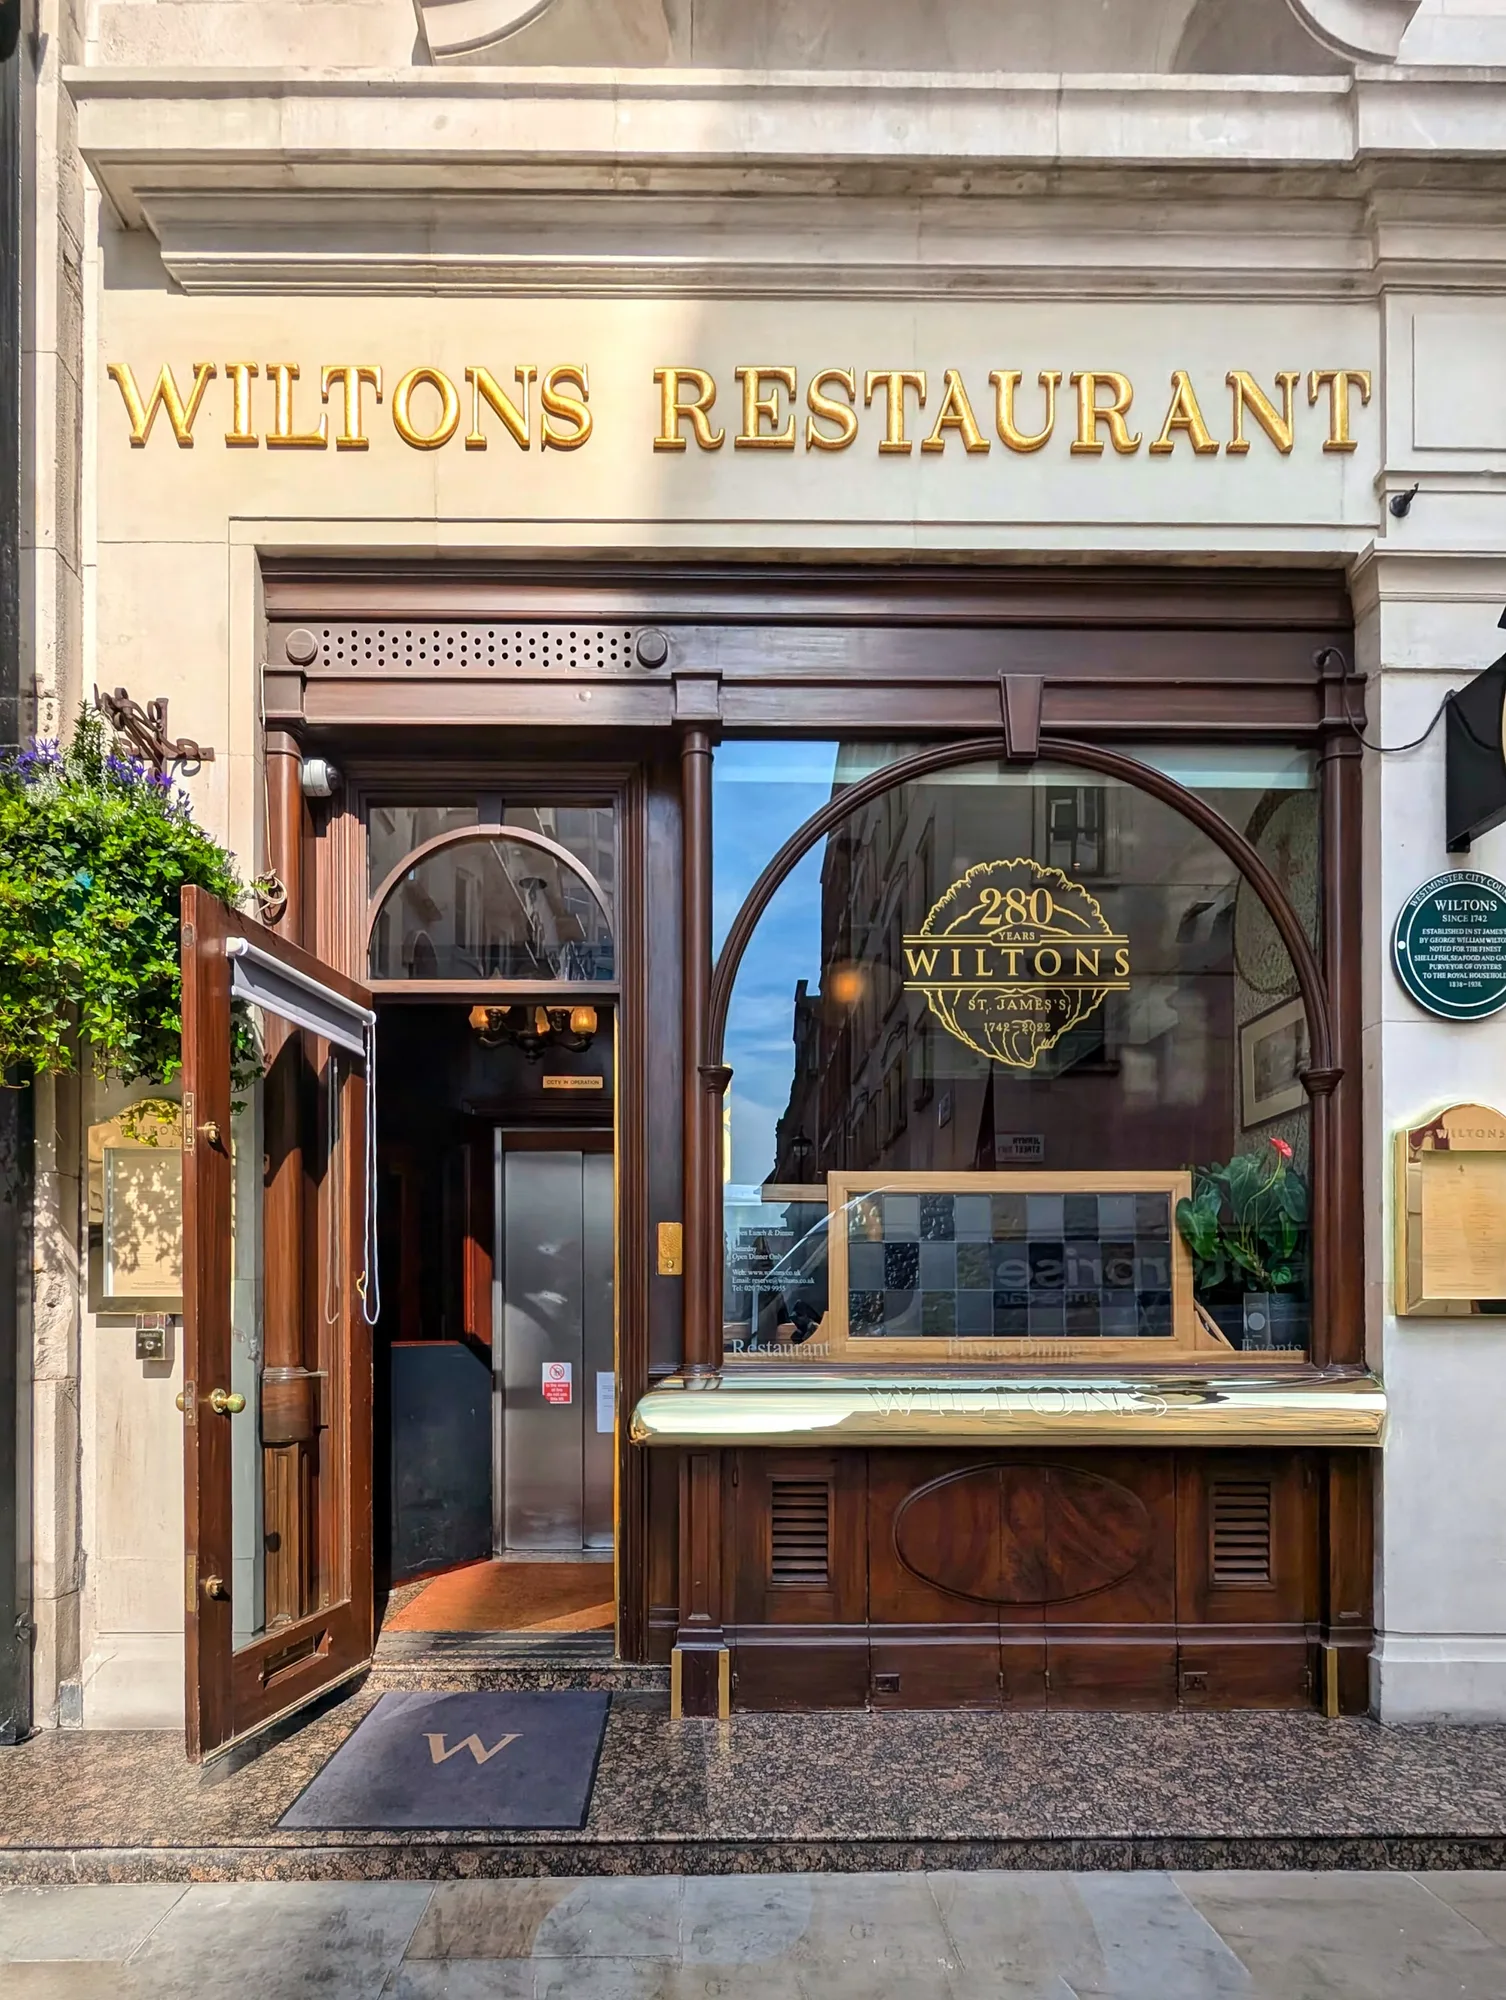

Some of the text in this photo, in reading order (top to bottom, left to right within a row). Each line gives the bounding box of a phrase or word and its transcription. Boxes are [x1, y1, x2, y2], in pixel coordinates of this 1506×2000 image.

[107, 362, 1372, 454] WILTONS RESTAURANT
[1410, 873, 1464, 907] WESTMINSTER
[1465, 873, 1487, 883] CITY
[979, 888, 1053, 925] 280
[1434, 899, 1498, 911] WILTONS
[999, 932, 1035, 940] YEARS
[903, 948, 1130, 977] WILTONS
[996, 999, 1066, 1011] JAMES'S
[1435, 1129, 1506, 1139] WILTONS
[731, 1339, 830, 1357] Restaurant
[948, 1338, 1012, 1357] Private
[1241, 1339, 1302, 1351] Events
[863, 1383, 1168, 1417] WILTONS
[422, 1733, 524, 1764] W
